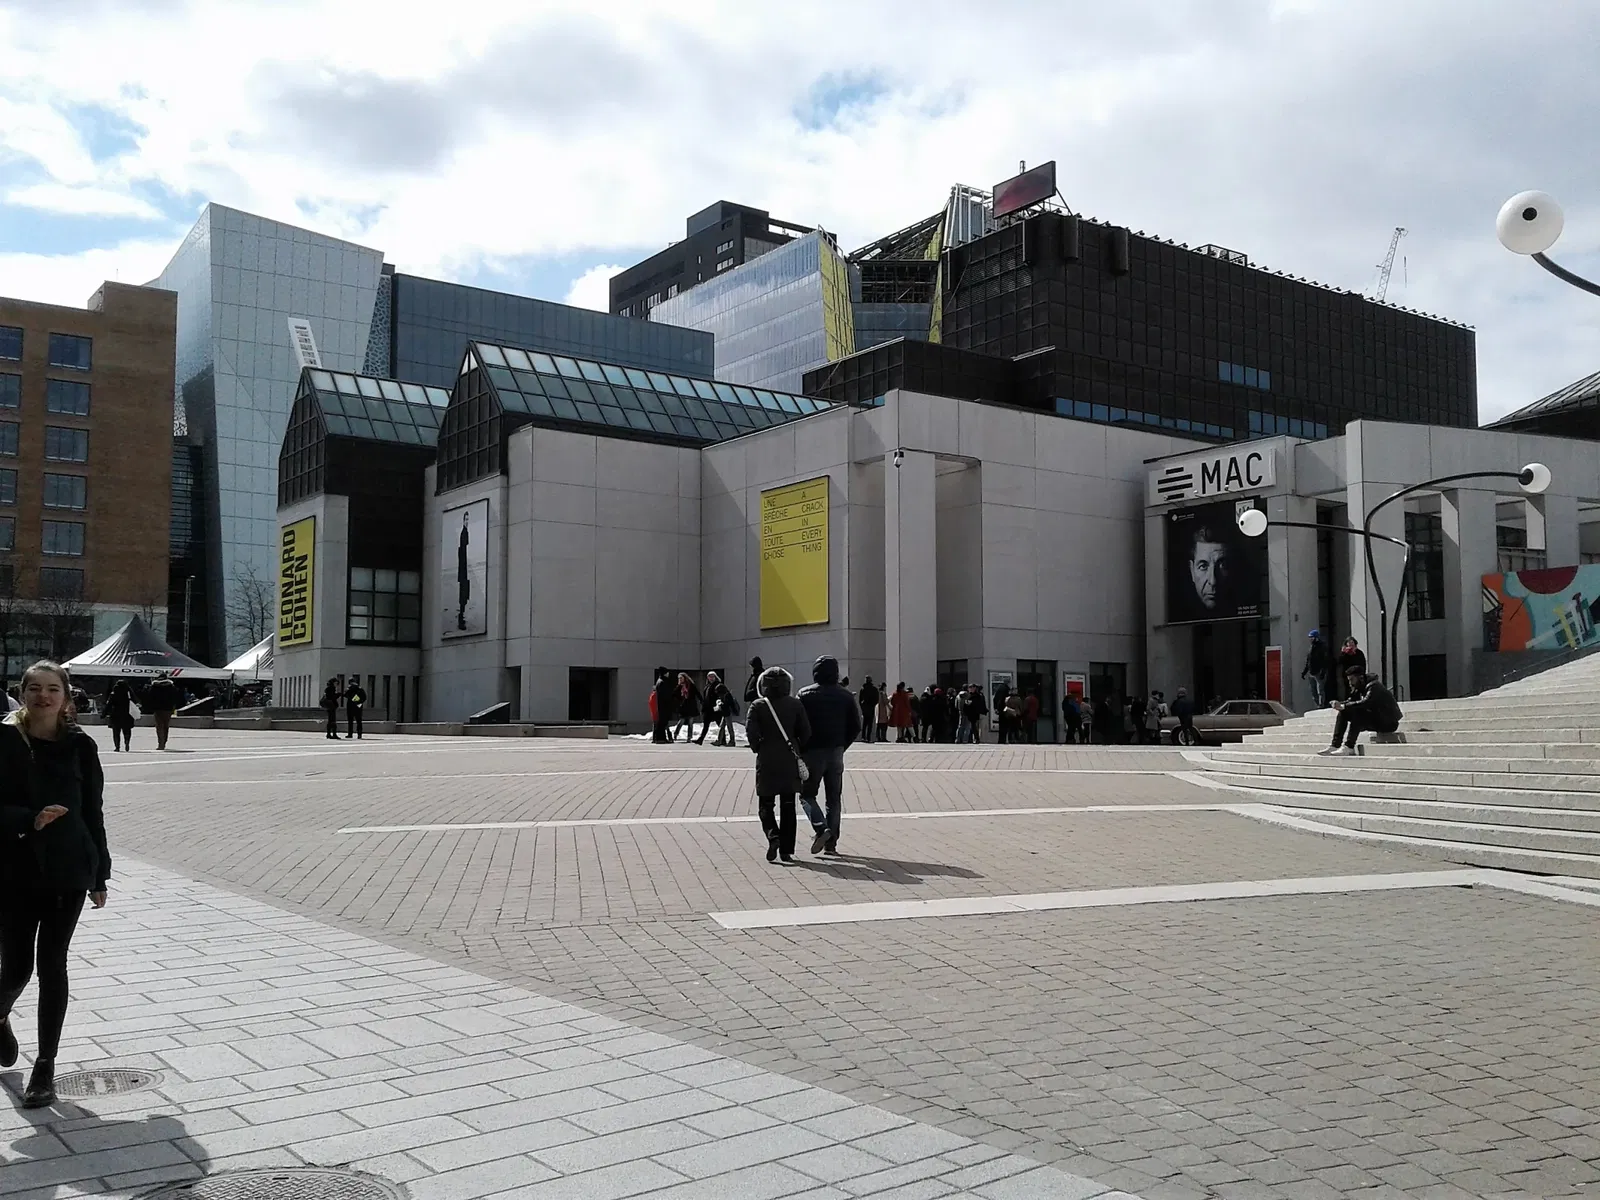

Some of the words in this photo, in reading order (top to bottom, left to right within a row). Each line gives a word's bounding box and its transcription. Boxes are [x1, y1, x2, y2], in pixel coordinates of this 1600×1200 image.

[1201, 452, 1263, 494] MAC
[802, 491, 806, 500] A
[764, 498, 776, 508] UNE
[802, 501, 824, 513] CRACK
[802, 518, 808, 527] IN
[764, 526, 772, 534] EN
[802, 528, 822, 540] EVERY
[764, 536, 784, 547] TOUTE
[802, 542, 822, 552] THING
[764, 549, 784, 560] CHOSE
[280, 529, 296, 642] LEONARD
[293, 553, 308, 640] COHEN
